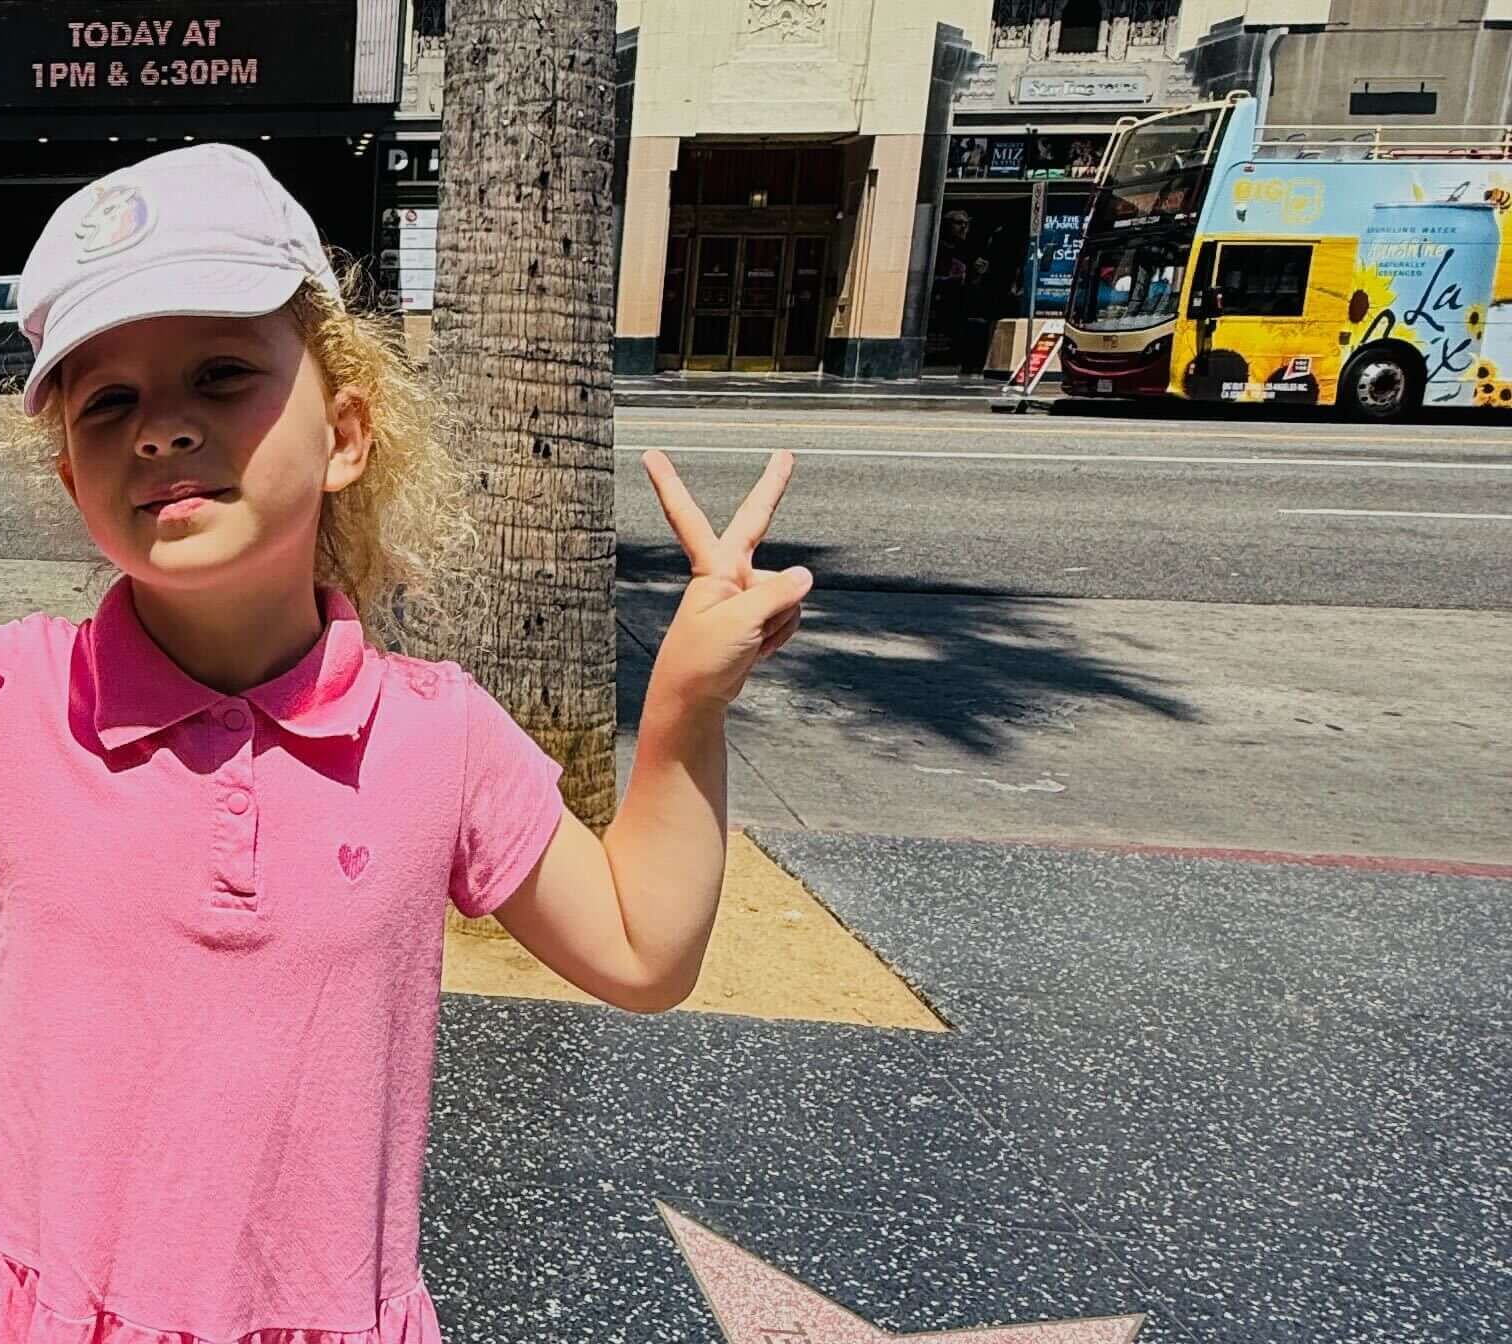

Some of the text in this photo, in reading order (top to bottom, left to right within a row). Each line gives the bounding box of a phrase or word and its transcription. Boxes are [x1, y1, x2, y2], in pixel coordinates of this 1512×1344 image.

[68, 19, 221, 47] TODAY AT
[32, 58, 258, 88] 1PM & 6:30PM
